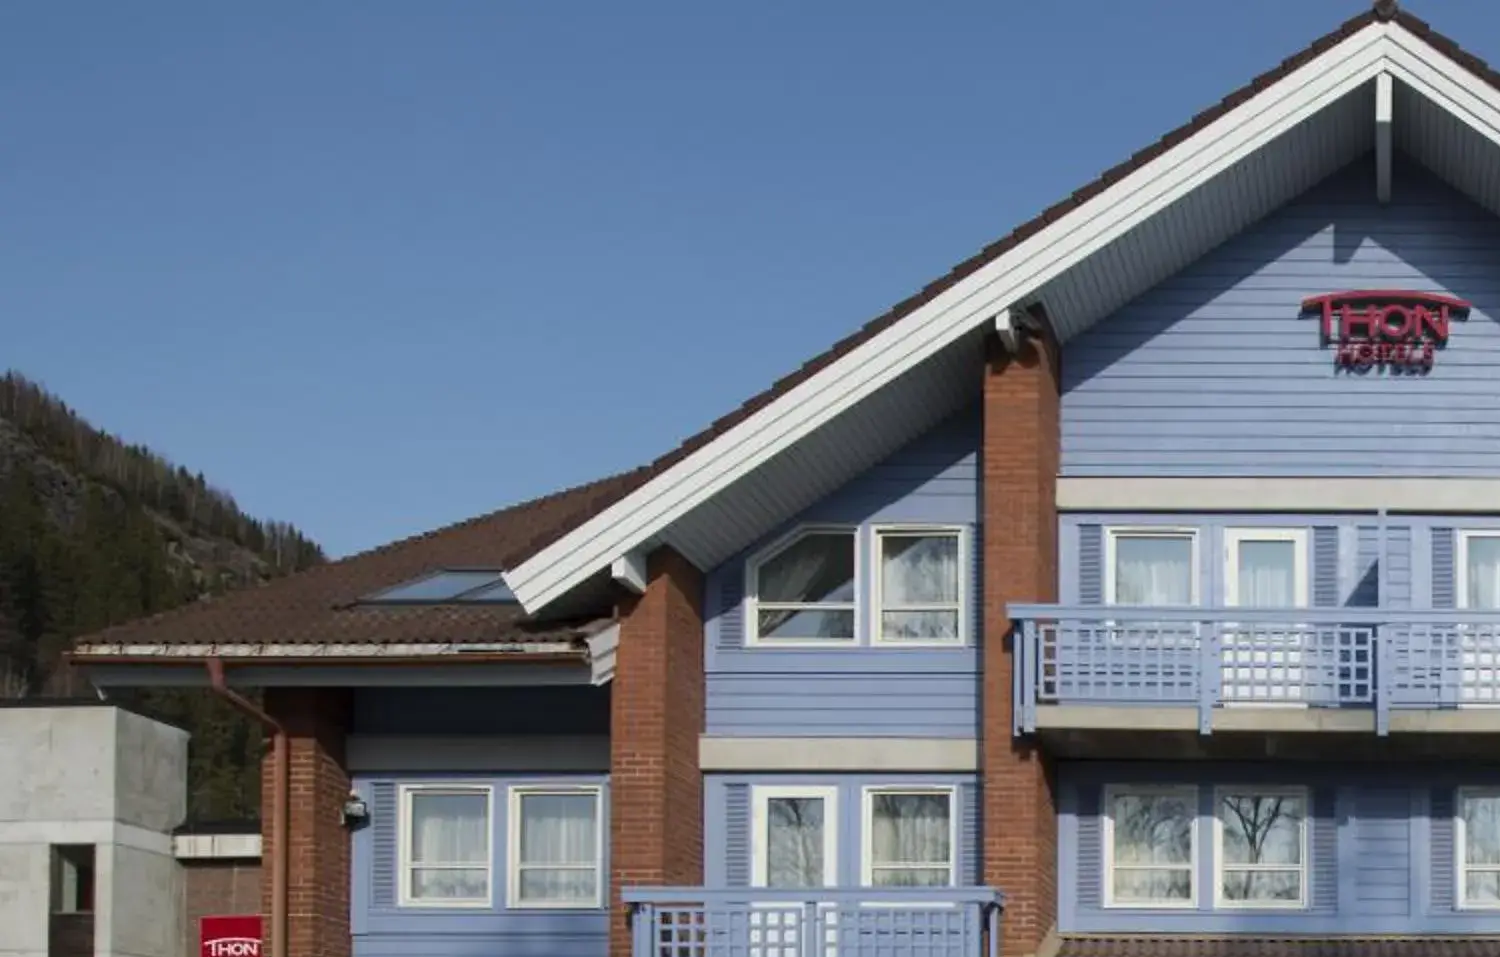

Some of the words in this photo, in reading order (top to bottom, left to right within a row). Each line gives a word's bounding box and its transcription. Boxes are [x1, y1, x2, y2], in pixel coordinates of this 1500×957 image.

[1301, 289, 1472, 338] THON
[1337, 342, 1436, 367] HOTELS
[203, 937, 262, 957] THON
